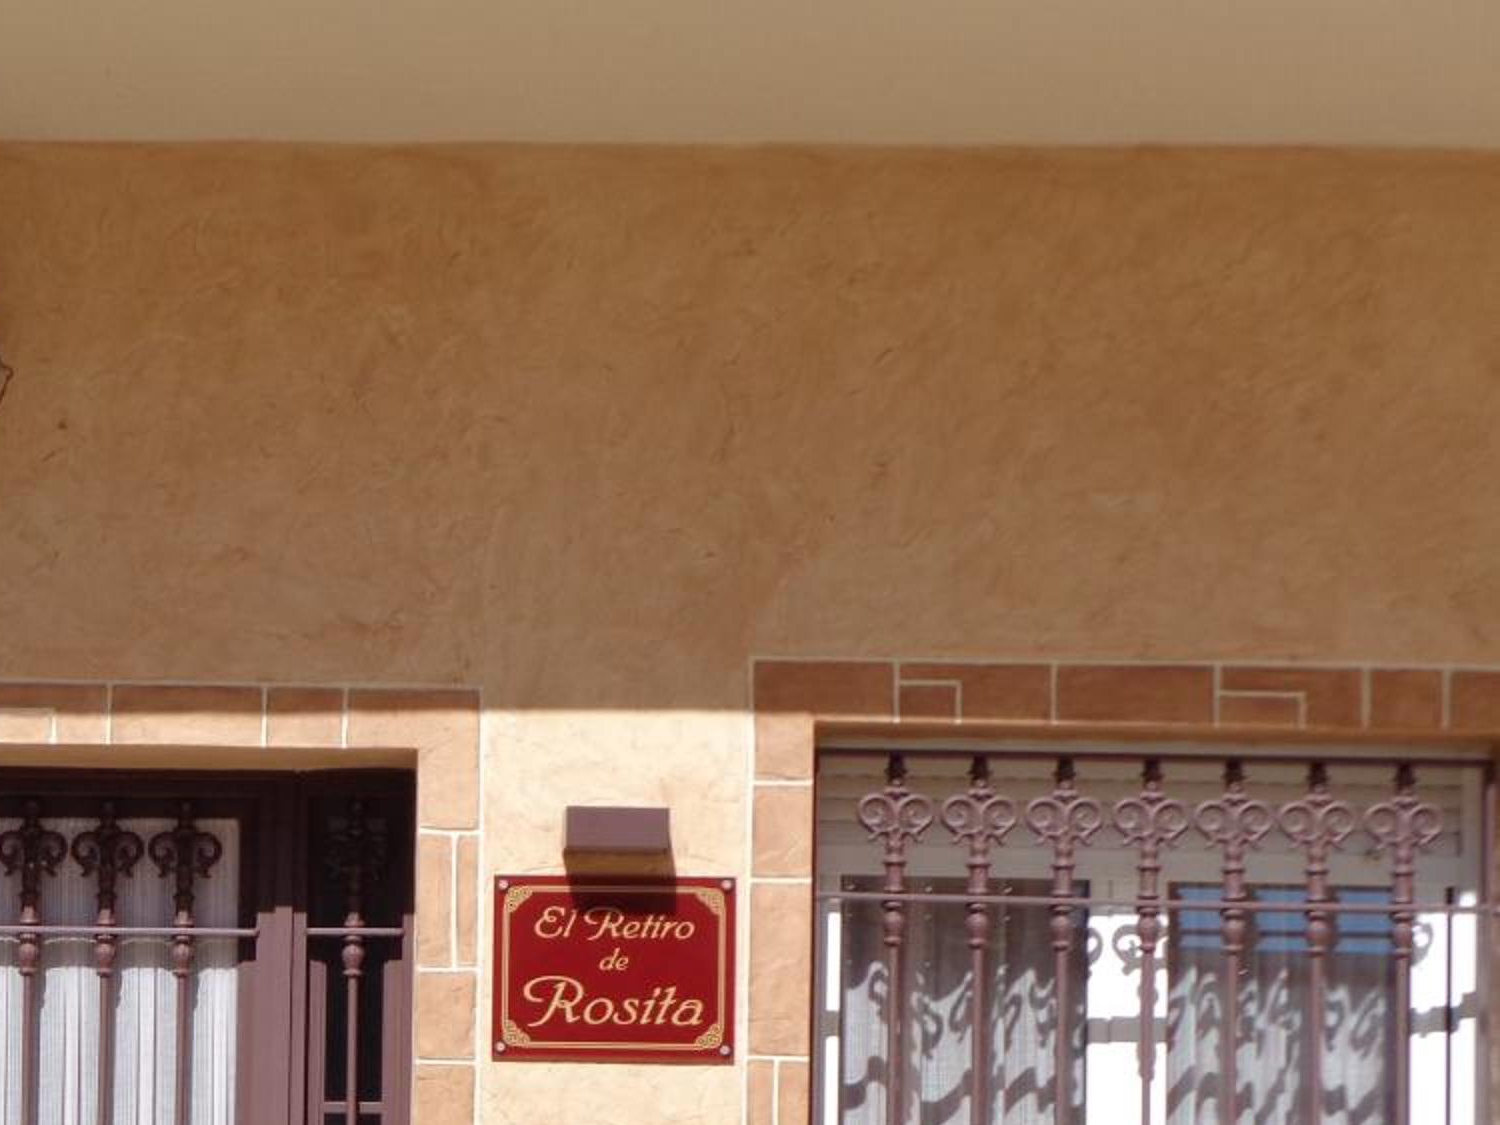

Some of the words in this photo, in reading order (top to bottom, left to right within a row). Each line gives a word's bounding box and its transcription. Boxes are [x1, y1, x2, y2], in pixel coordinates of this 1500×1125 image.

[533, 905, 578, 939] El
[583, 906, 696, 941] Retiro
[598, 947, 629, 971] de
[523, 975, 705, 1028] Rosita
